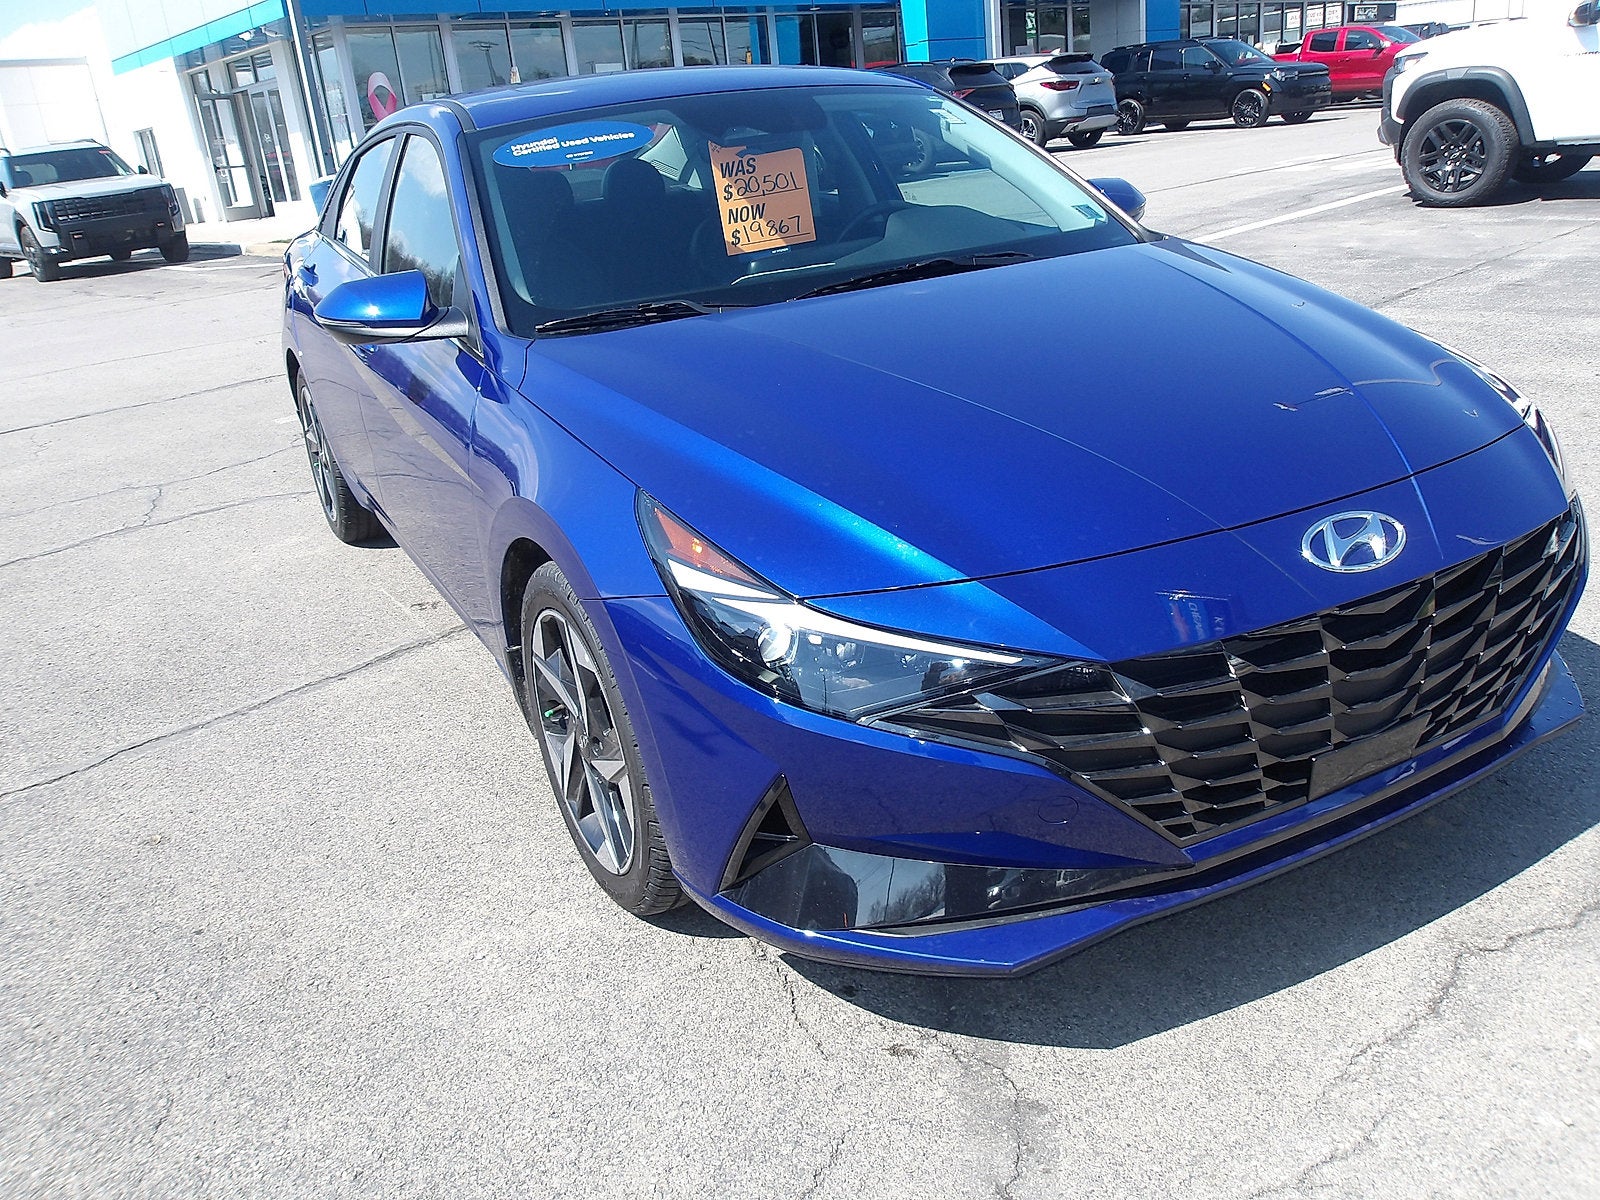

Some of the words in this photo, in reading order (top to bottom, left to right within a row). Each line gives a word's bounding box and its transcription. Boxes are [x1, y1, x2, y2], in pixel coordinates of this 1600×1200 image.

[510, 136, 557, 151] Hyundai
[512, 142, 561, 156] Certified
[561, 136, 590, 148] Used
[589, 132, 636, 143] Vehicles
[720, 157, 757, 179] WAS
[723, 172, 799, 202] $20,501
[727, 203, 766, 225] NOW
